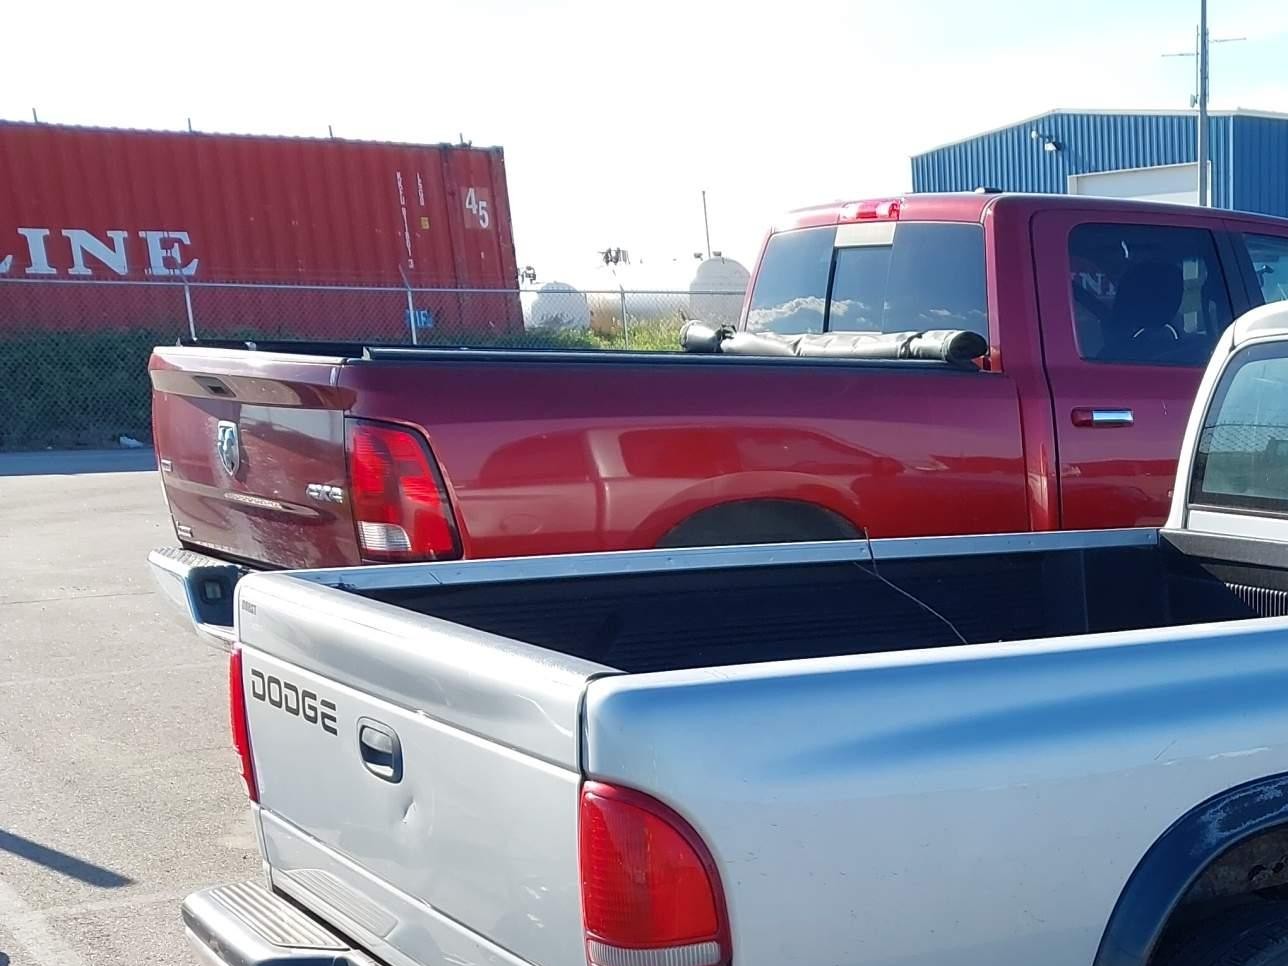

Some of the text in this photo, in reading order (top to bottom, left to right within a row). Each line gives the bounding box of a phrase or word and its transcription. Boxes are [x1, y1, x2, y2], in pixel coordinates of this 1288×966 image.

[465, 187, 489, 229] 45
[0, 227, 199, 276] INE
[251, 668, 338, 737] DODGE
